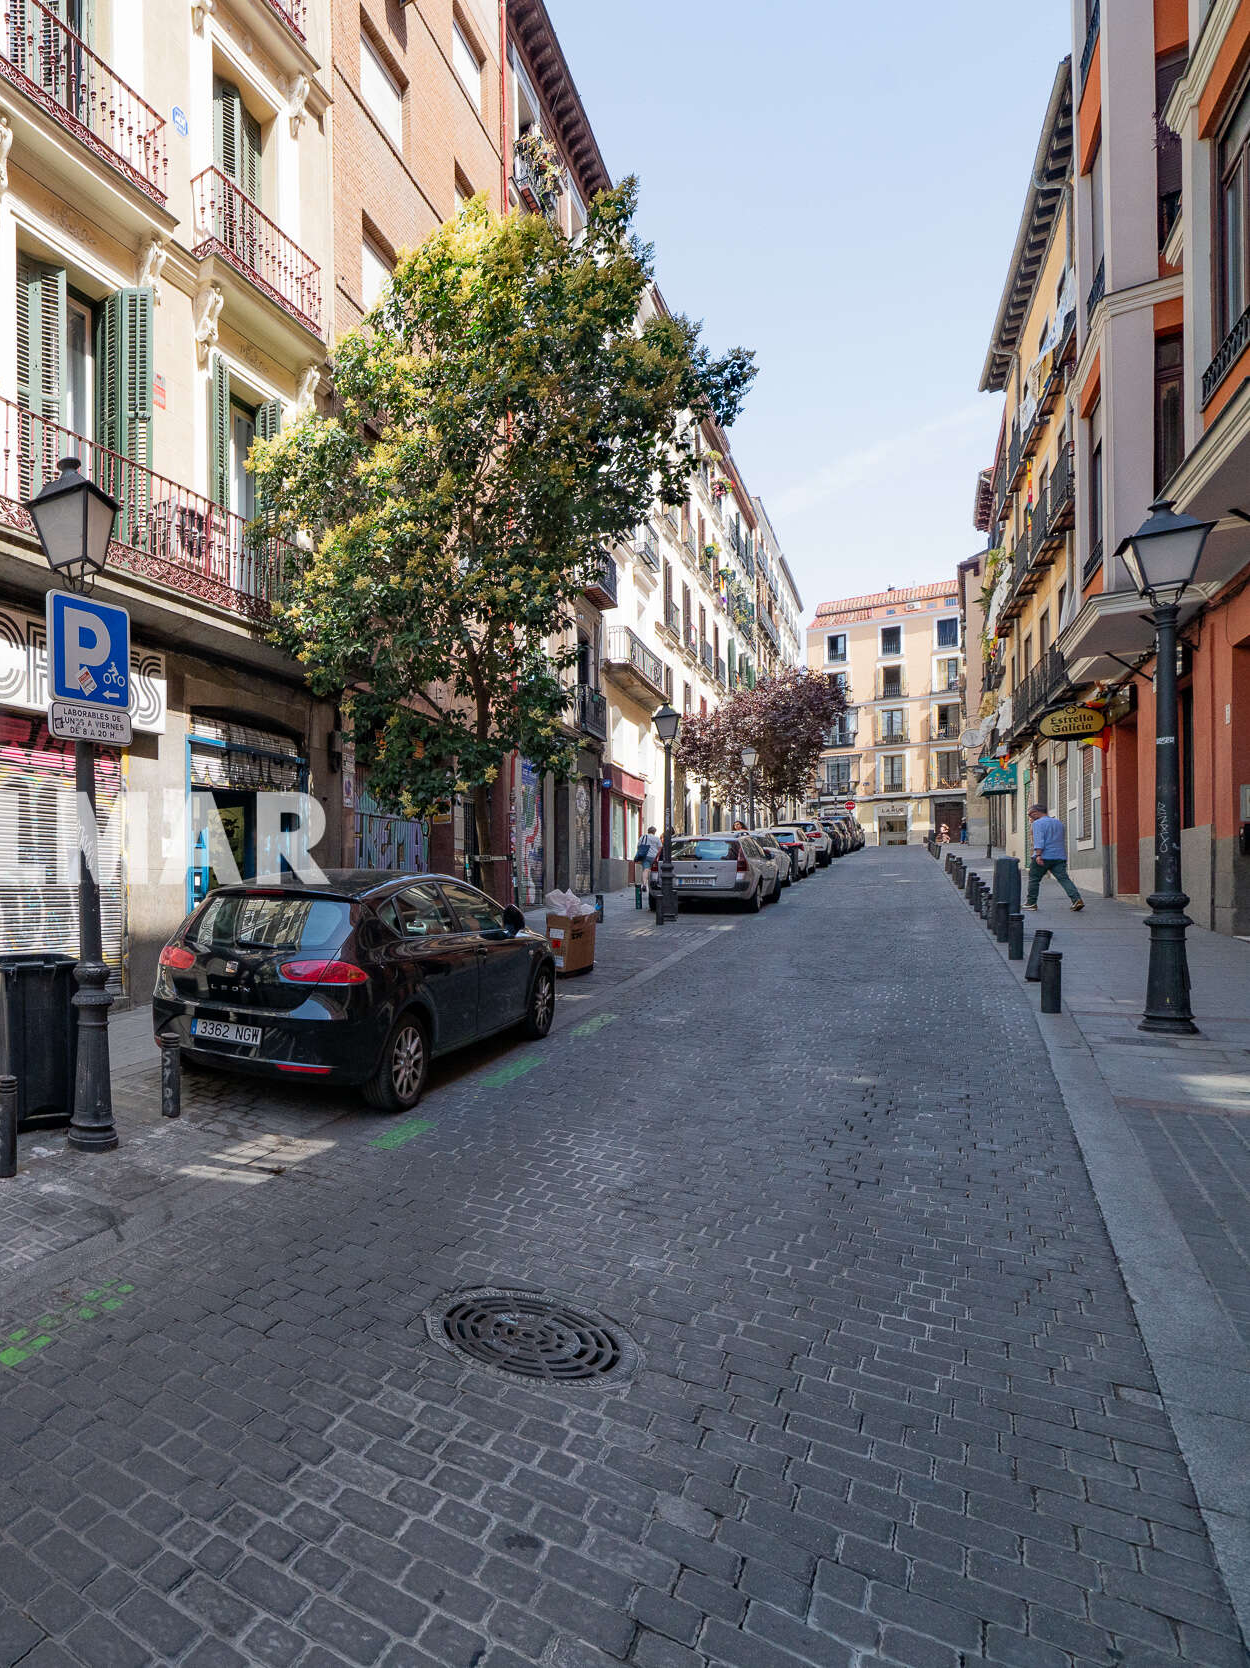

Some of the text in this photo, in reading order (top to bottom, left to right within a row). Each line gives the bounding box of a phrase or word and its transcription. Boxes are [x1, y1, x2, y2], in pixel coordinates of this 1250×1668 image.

[63, 606, 111, 691] P
[63, 708, 122, 723] LABORABLES DE
[1051, 714, 1094, 724] Estrella
[95, 720, 125, 731] VIERNES
[1052, 722, 1092, 733] Galicia
[70, 727, 80, 735] DE
[98, 730, 107, 738] 20
[211, 983, 250, 993] LEON
[200, 1021, 260, 1044] 3362 NGW
